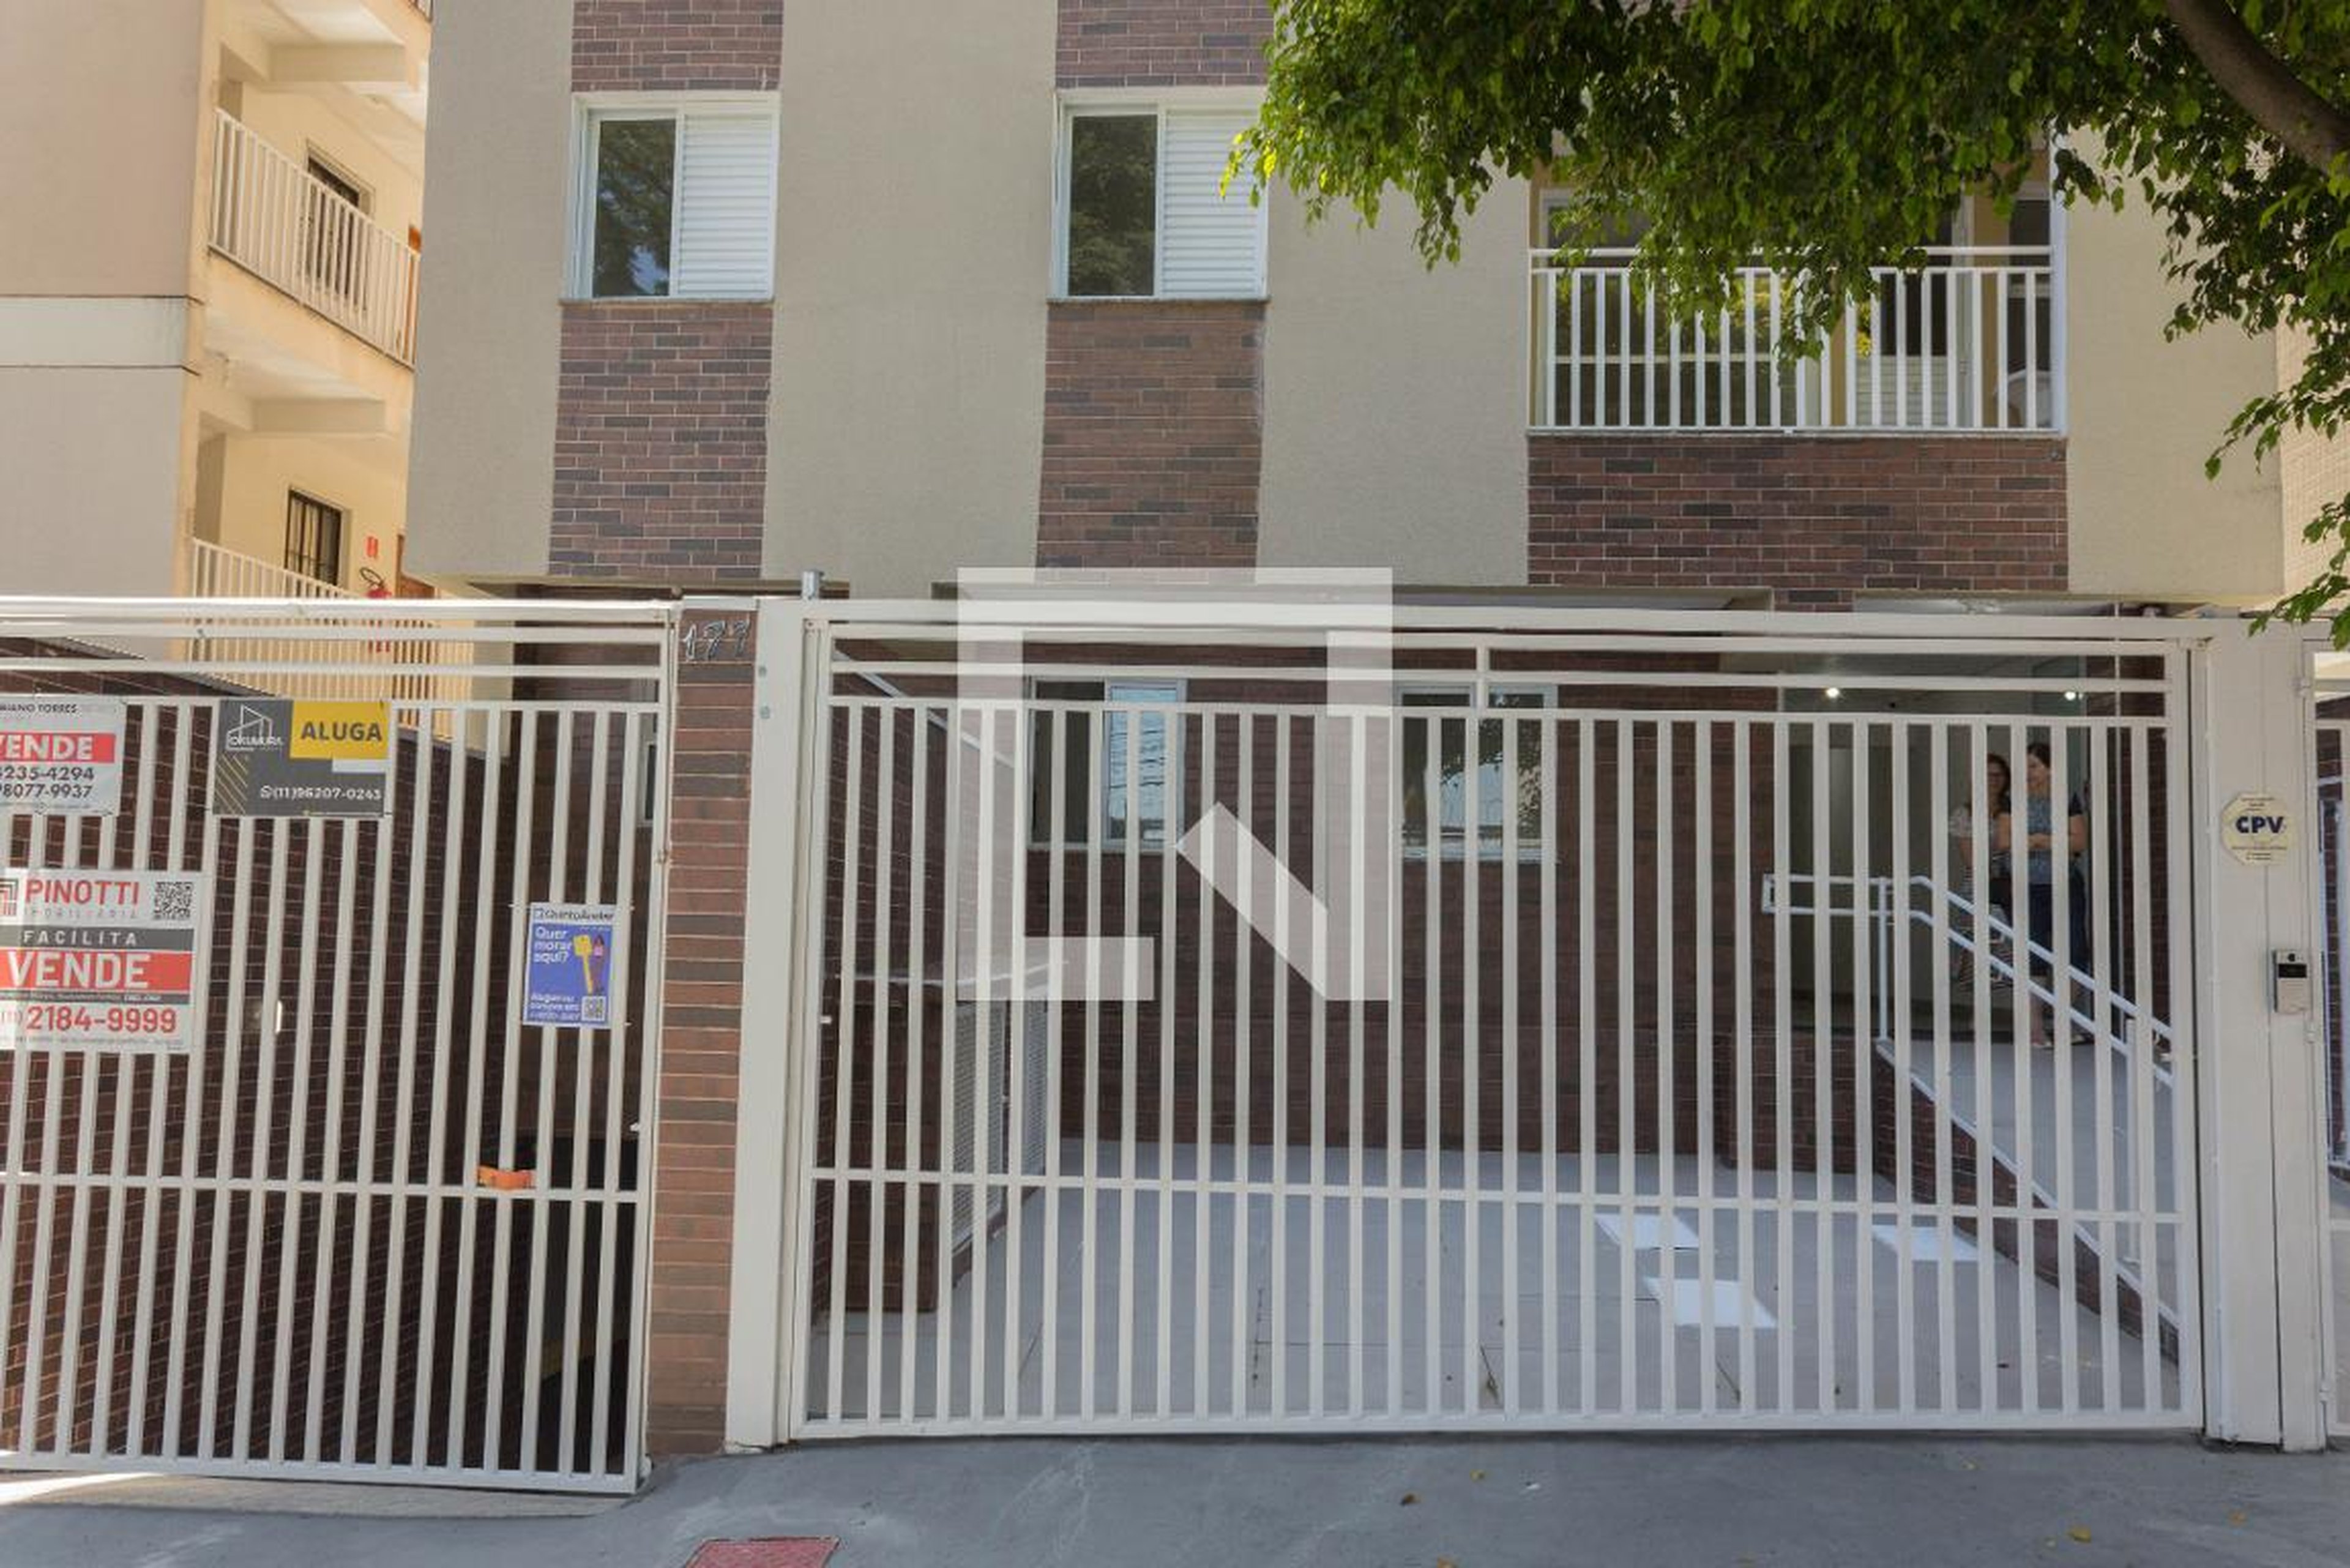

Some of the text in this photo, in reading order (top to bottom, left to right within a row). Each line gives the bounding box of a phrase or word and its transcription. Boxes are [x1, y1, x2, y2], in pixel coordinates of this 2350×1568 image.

[38, 704, 78, 713] TORRES
[301, 721, 382, 742] ALUGA
[0, 766, 94, 782] 235-4294
[0, 783, 93, 798] 8077-9937
[2236, 816, 2285, 834] CPV
[25, 879, 140, 905] PINOTTI
[23, 930, 137, 946] FACILITA
[7, 950, 152, 989] VENDE
[26, 1006, 177, 1033] 2184-9999
